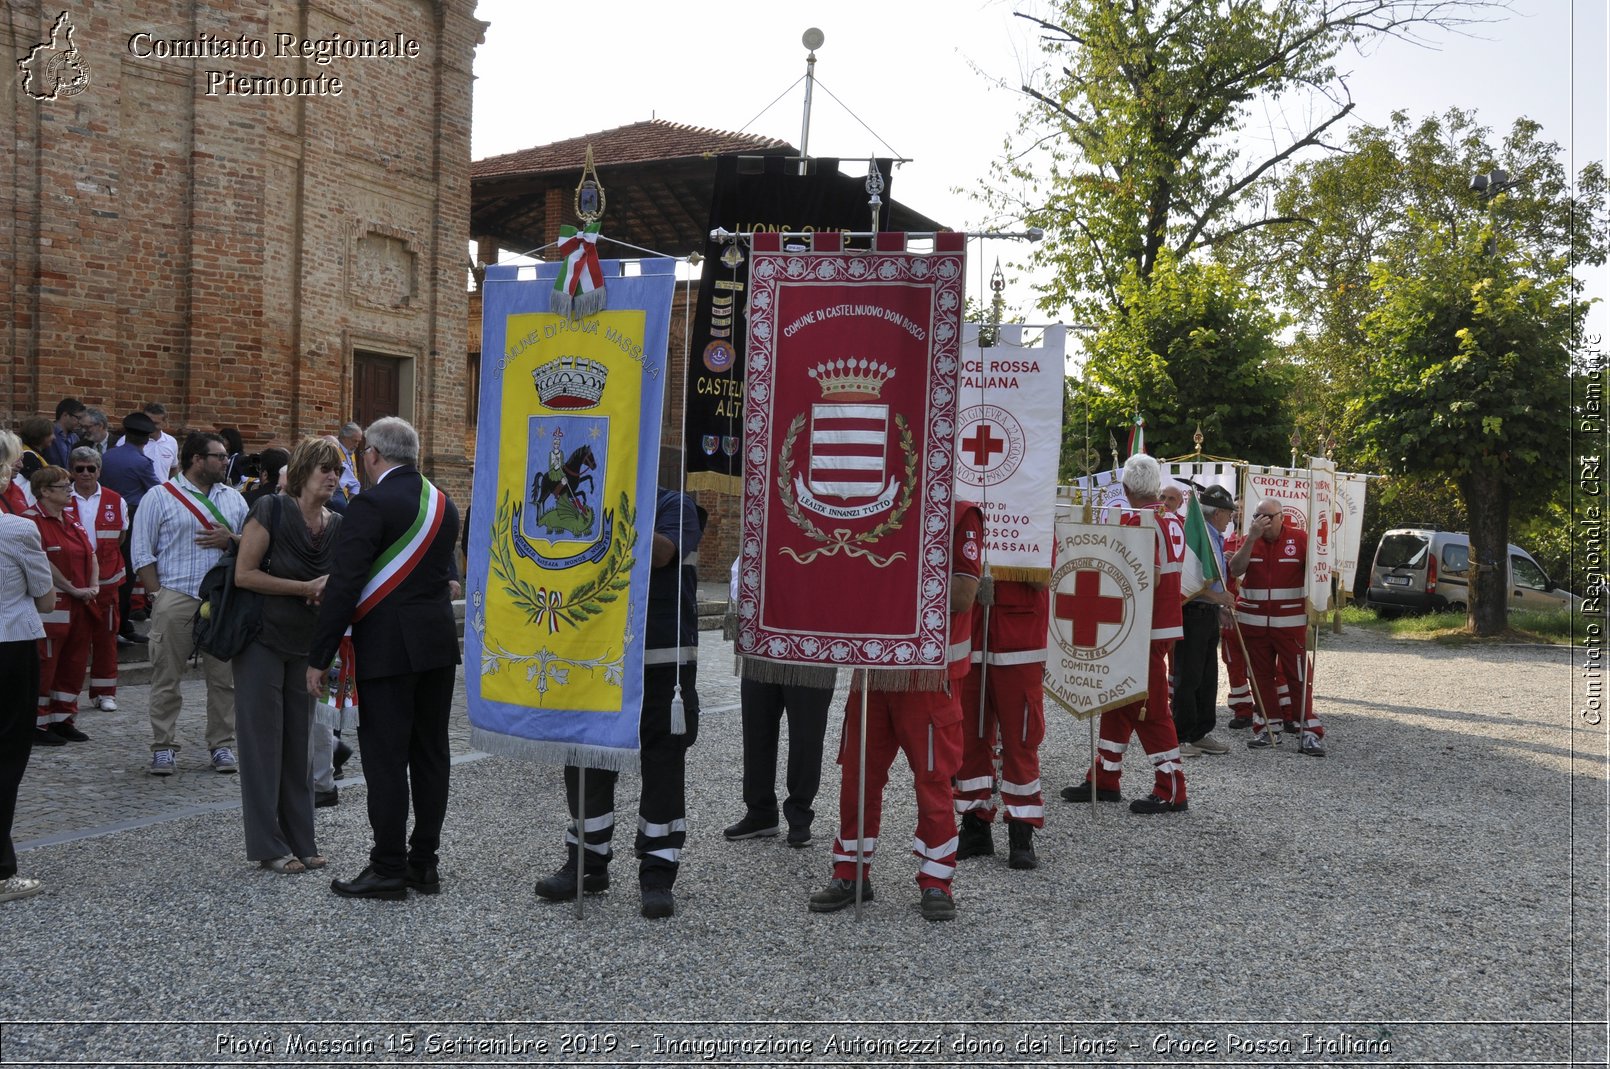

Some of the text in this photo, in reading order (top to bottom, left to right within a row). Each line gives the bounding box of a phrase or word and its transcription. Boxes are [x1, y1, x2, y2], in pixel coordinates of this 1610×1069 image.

[784, 304, 926, 342] COMUNE DI CASTELNUOVO DON BOSCO
[493, 329, 540, 380] COMUNE
[544, 323, 557, 338] DI
[604, 325, 660, 381] MASSAIA
[990, 361, 1041, 373] ROSSA
[967, 407, 1008, 426] GINEVRA
[1003, 436, 1022, 473] AGOSTO
[1253, 476, 1290, 488] CROCE
[829, 508, 860, 518] INNANZI
[863, 499, 891, 514] TUTTO
[998, 503, 1007, 511] DI
[982, 541, 1040, 553] MASSAIA
[1065, 533, 1107, 549] ROSSA
[1109, 538, 1149, 592] ITALIANA
[1049, 559, 1134, 600] CONVENZIONE DI GINEVRA
[1061, 658, 1110, 675] COMITATO
[1064, 674, 1103, 689] LOCALE
[1098, 676, 1137, 705] D'ASTI
